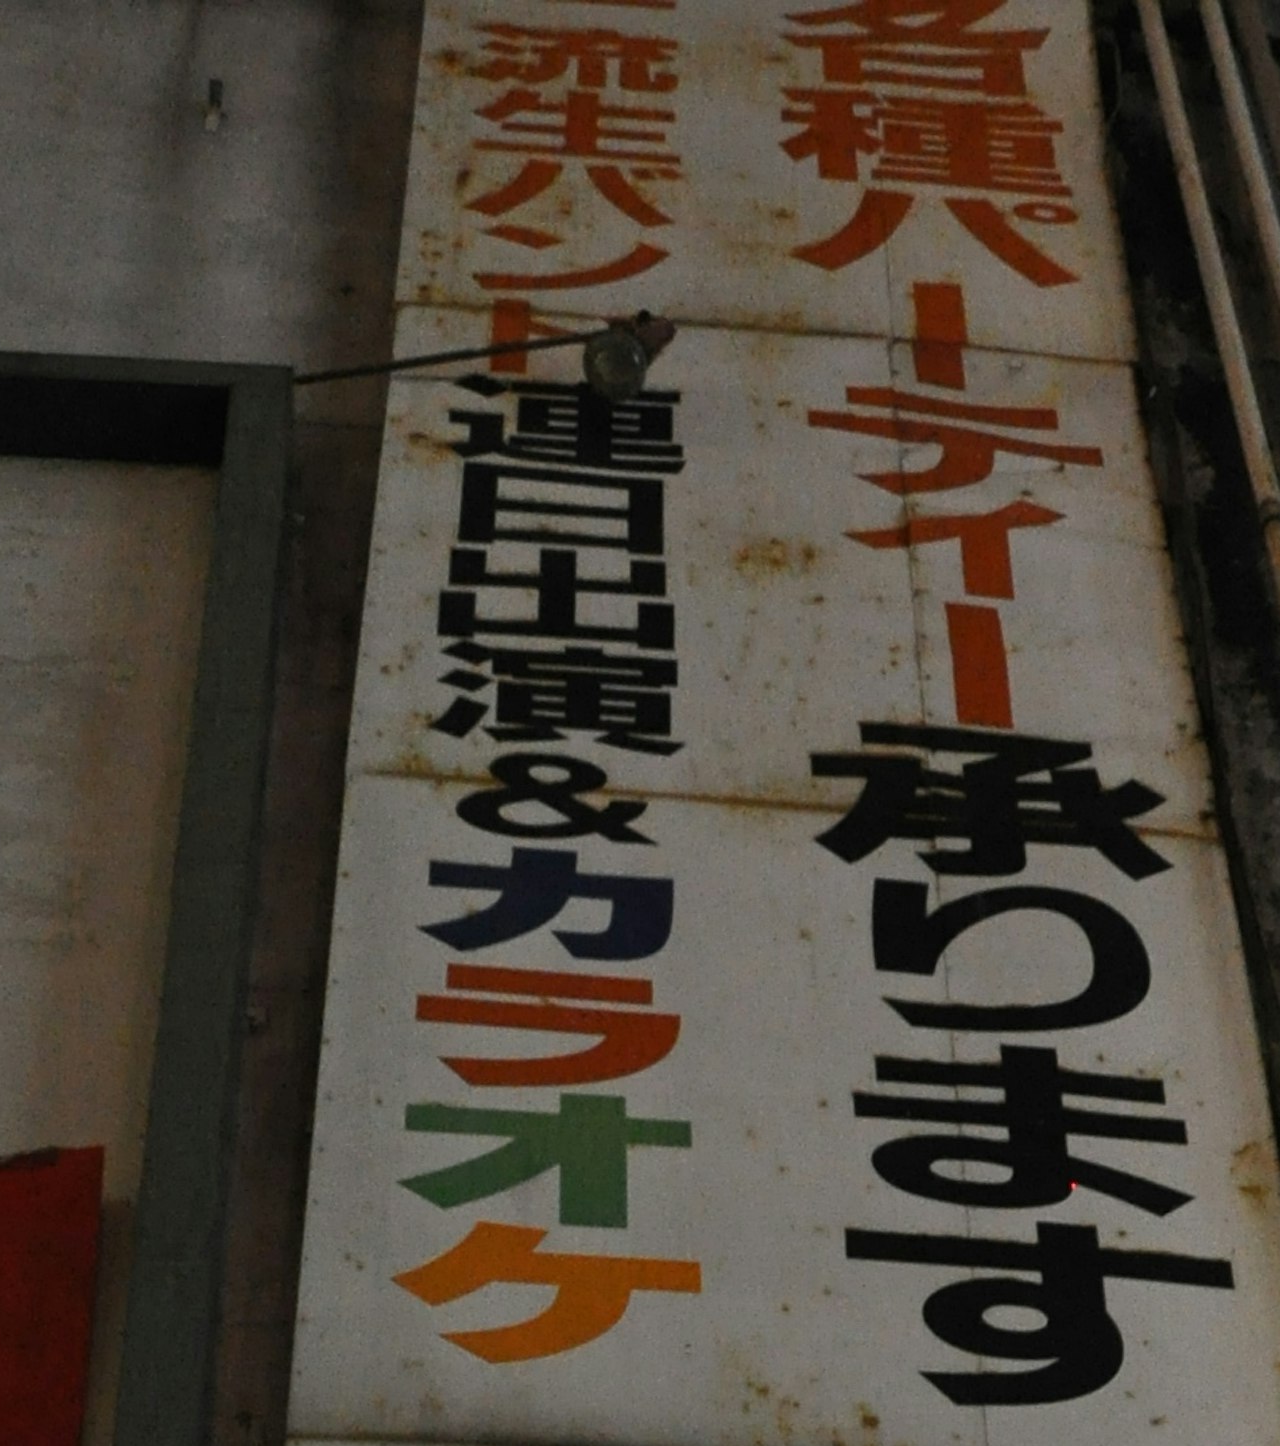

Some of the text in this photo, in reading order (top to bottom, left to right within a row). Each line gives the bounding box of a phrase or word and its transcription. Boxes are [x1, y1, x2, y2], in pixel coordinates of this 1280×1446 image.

[778, 0, 1234, 1404] 各種パーティー承ります
